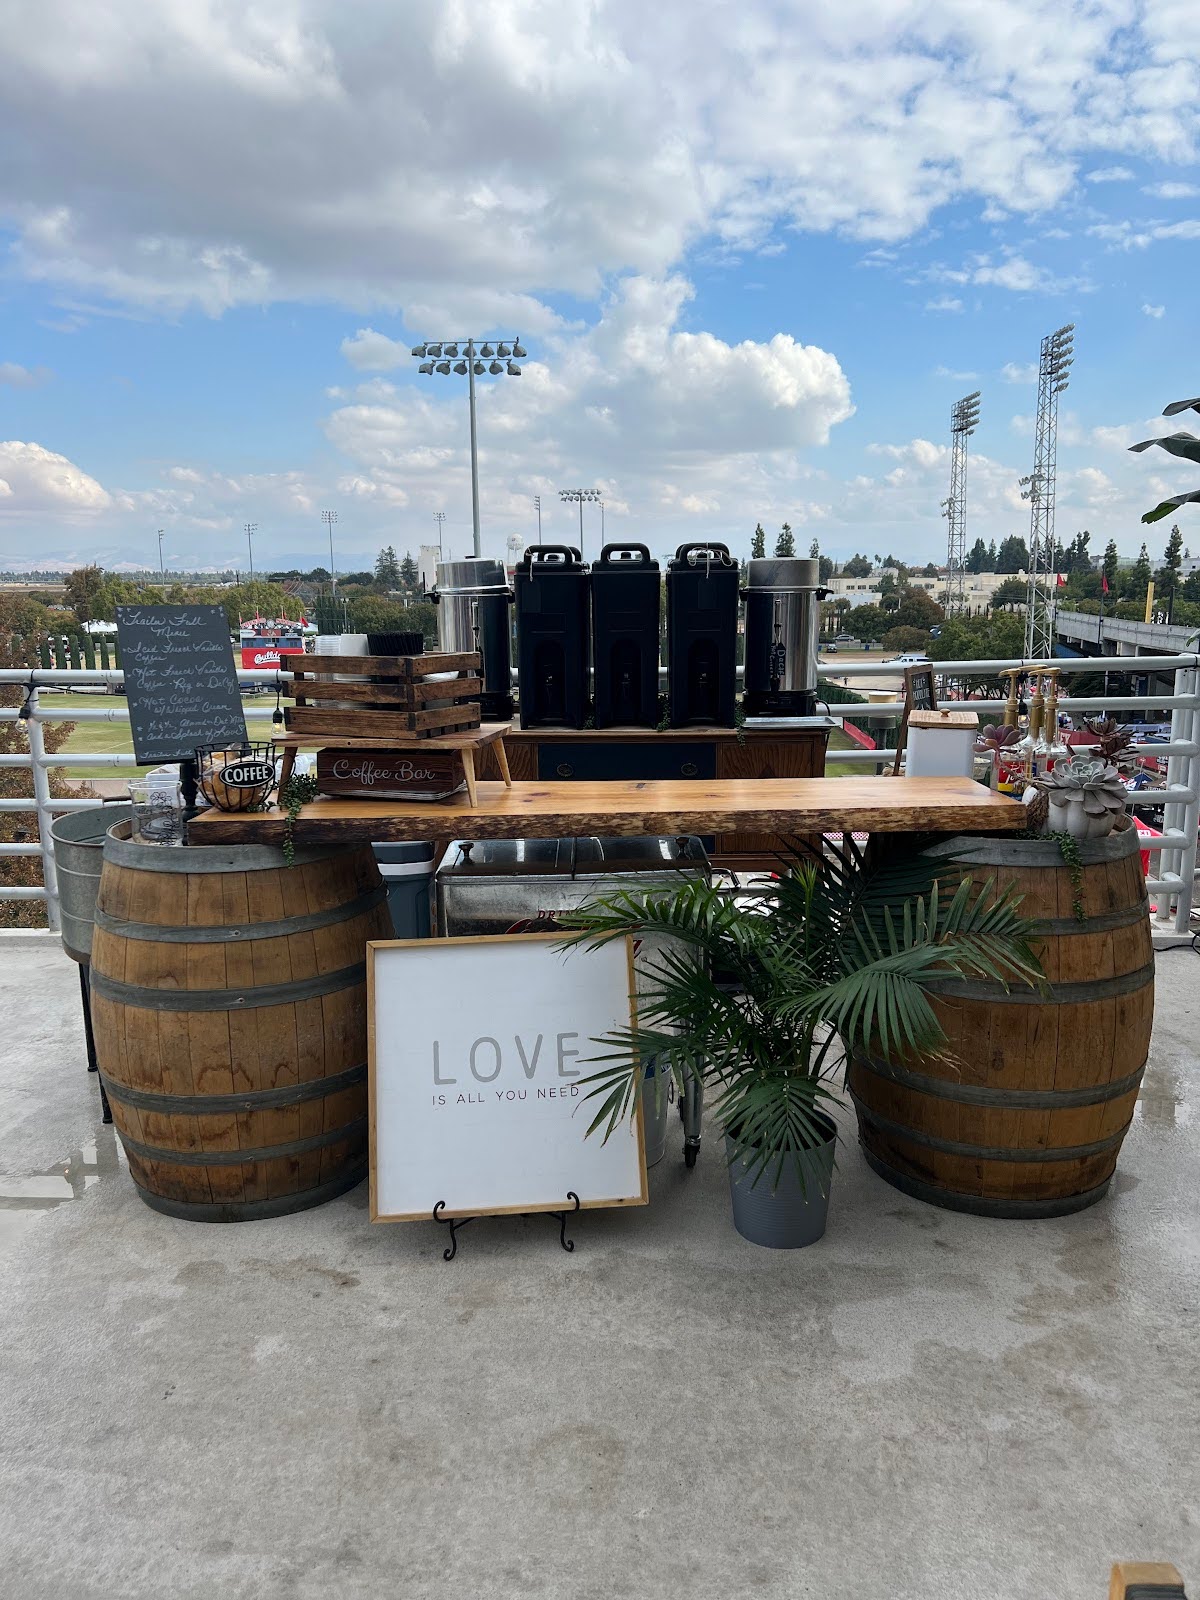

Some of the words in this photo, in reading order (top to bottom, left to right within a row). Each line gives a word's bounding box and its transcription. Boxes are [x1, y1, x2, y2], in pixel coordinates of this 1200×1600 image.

[150, 626, 191, 638] Menu
[127, 641, 159, 654] Iced
[161, 640, 192, 654] French
[192, 640, 225, 653] Vanilla
[134, 652, 168, 666] Coffee
[132, 665, 158, 680] Hot
[160, 664, 194, 677] French
[195, 660, 228, 675] Vanilla
[137, 678, 167, 692] Coffee
[138, 695, 166, 710] Hot
[169, 693, 204, 705] Cocoa
[201, 702, 232, 713] Cream
[224, 765, 269, 783] COFFEE
[332, 759, 393, 785] Coffee
[394, 759, 436, 783] Bar
[432, 1031, 581, 1086] LOVE
[432, 1094, 446, 1106] IS
[456, 1092, 486, 1104] ALL
[495, 1089, 527, 1101] YOU
[537, 1086, 580, 1100] NEED
